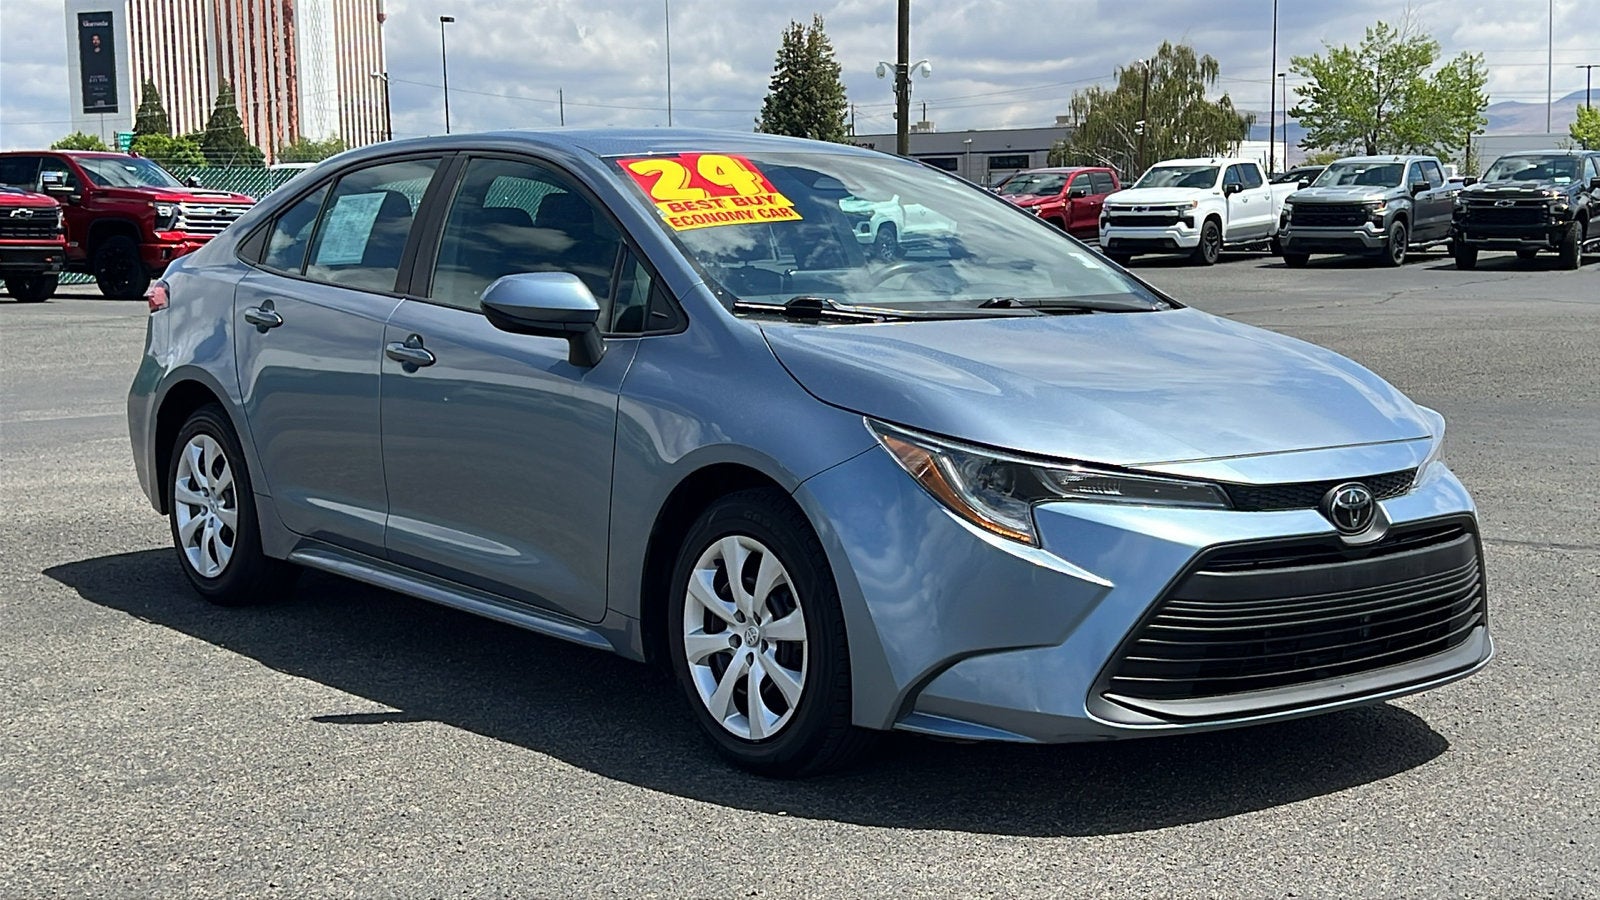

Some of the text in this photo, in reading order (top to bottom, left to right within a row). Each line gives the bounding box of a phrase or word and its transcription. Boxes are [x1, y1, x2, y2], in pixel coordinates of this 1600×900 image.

[628, 154, 765, 201] 24
[667, 195, 776, 213] BEST BUY
[669, 207, 794, 227] ECONOMY CAR
